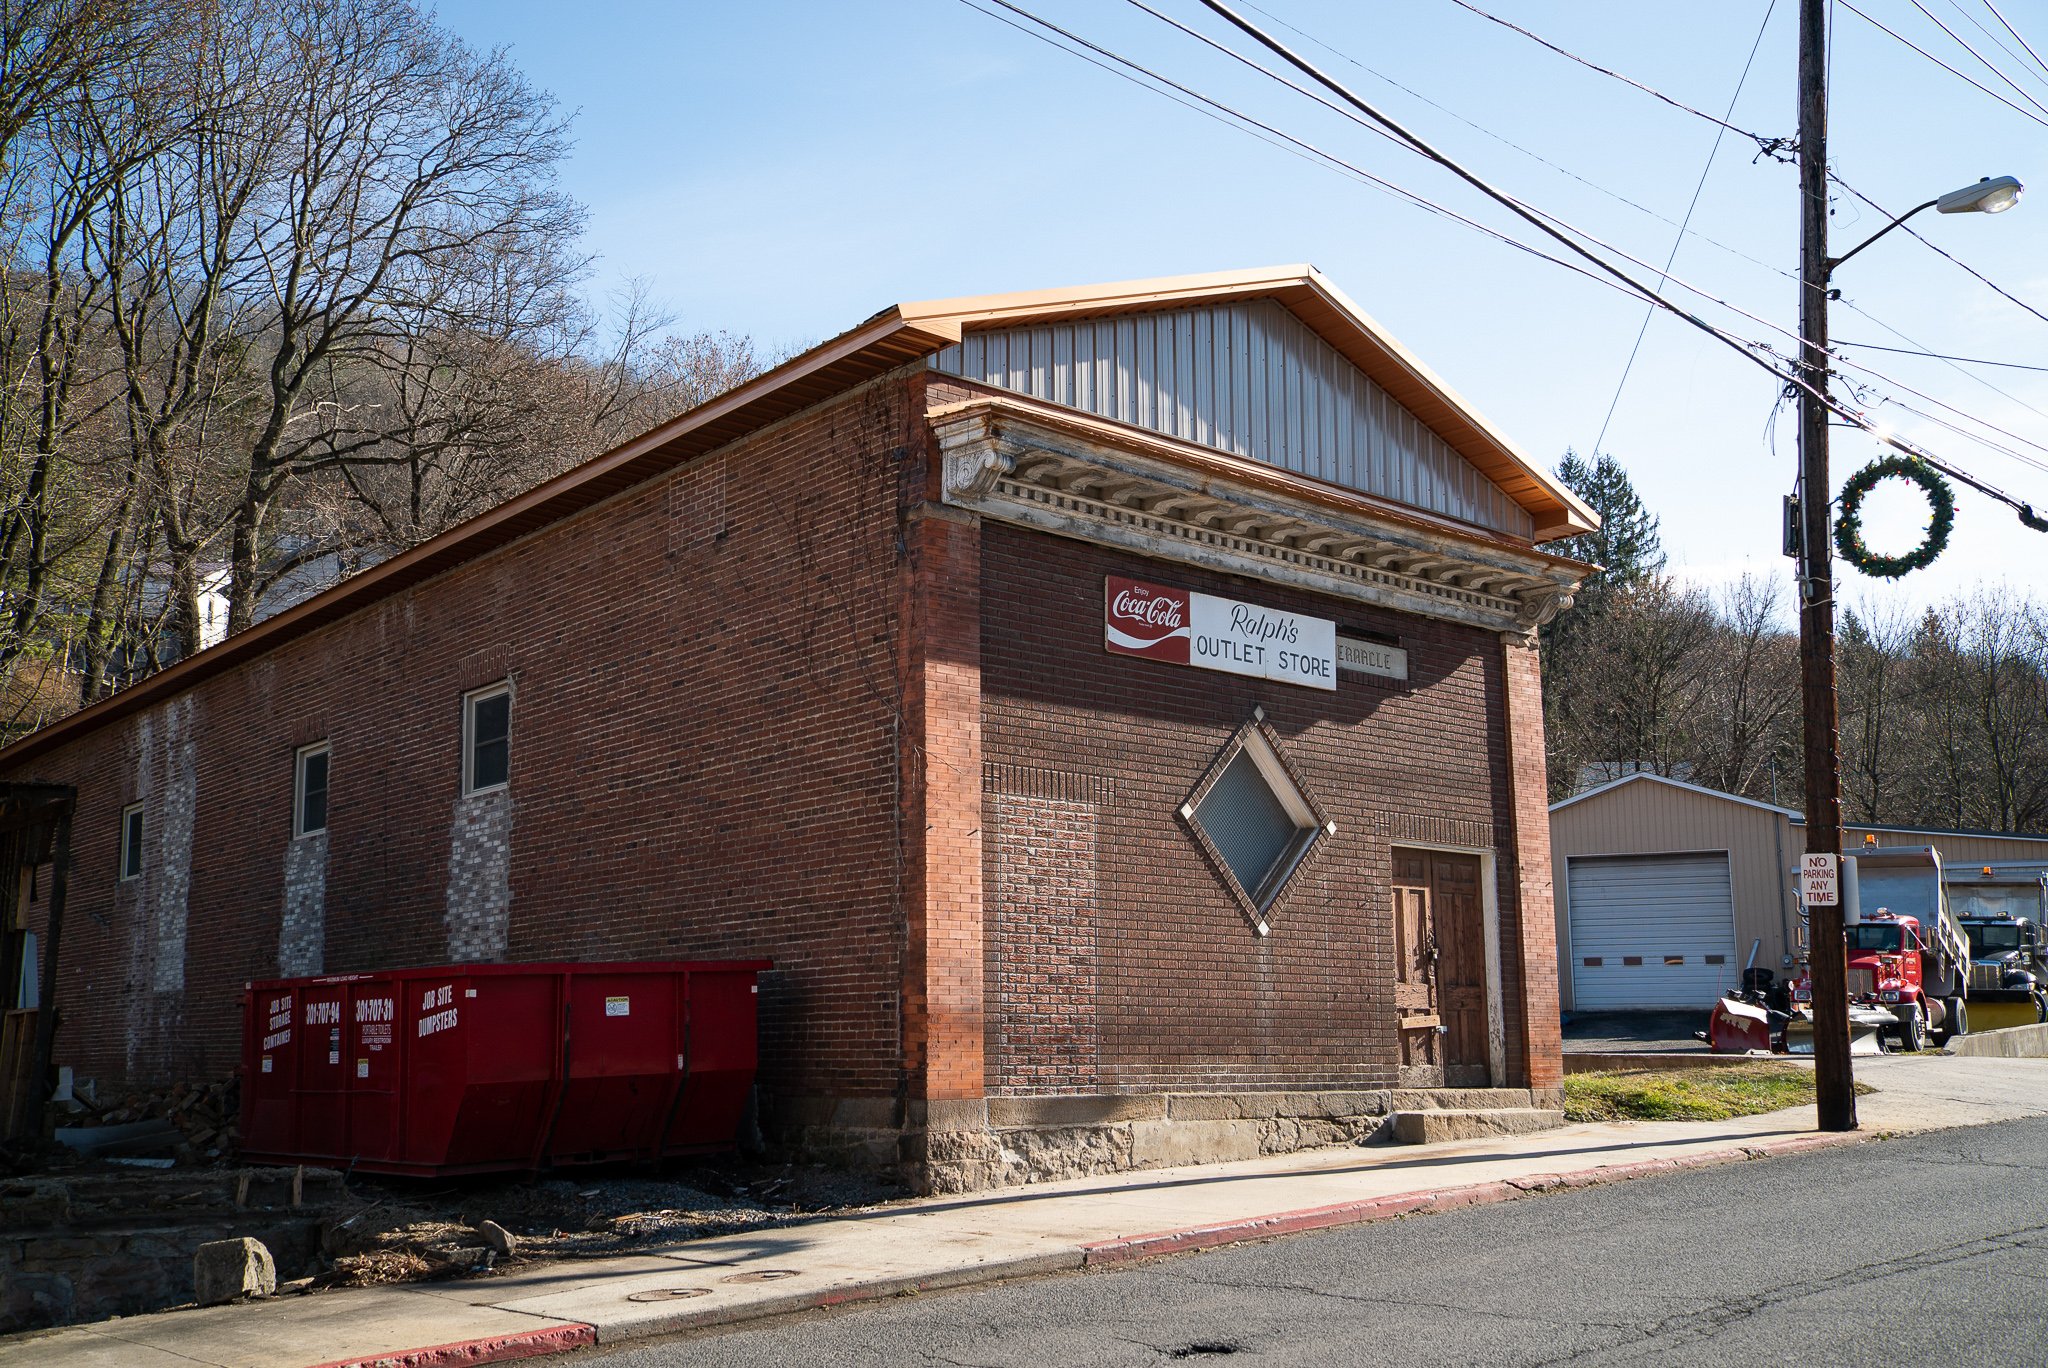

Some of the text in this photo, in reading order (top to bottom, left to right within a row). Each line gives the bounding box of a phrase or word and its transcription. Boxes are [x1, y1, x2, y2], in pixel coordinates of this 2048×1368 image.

[1134, 586, 1150, 597] Enjoy
[1113, 590, 1184, 628] Coca-Cola
[1231, 604, 1298, 644] Ralph's
[1197, 635, 1330, 678] OUTLET STORE
[1809, 857, 1827, 867] NO
[1804, 869, 1834, 878] PARKING
[1810, 881, 1828, 890] ANY
[1806, 892, 1834, 902] TIME
[270, 995, 292, 1015] JOB SITE
[423, 990, 436, 1011] JOB
[437, 984, 452, 1007] SITE
[269, 1010, 291, 1031] STORAGE
[356, 998, 394, 1022] 301-707-31
[418, 1007, 458, 1038] DUMPSTERS
